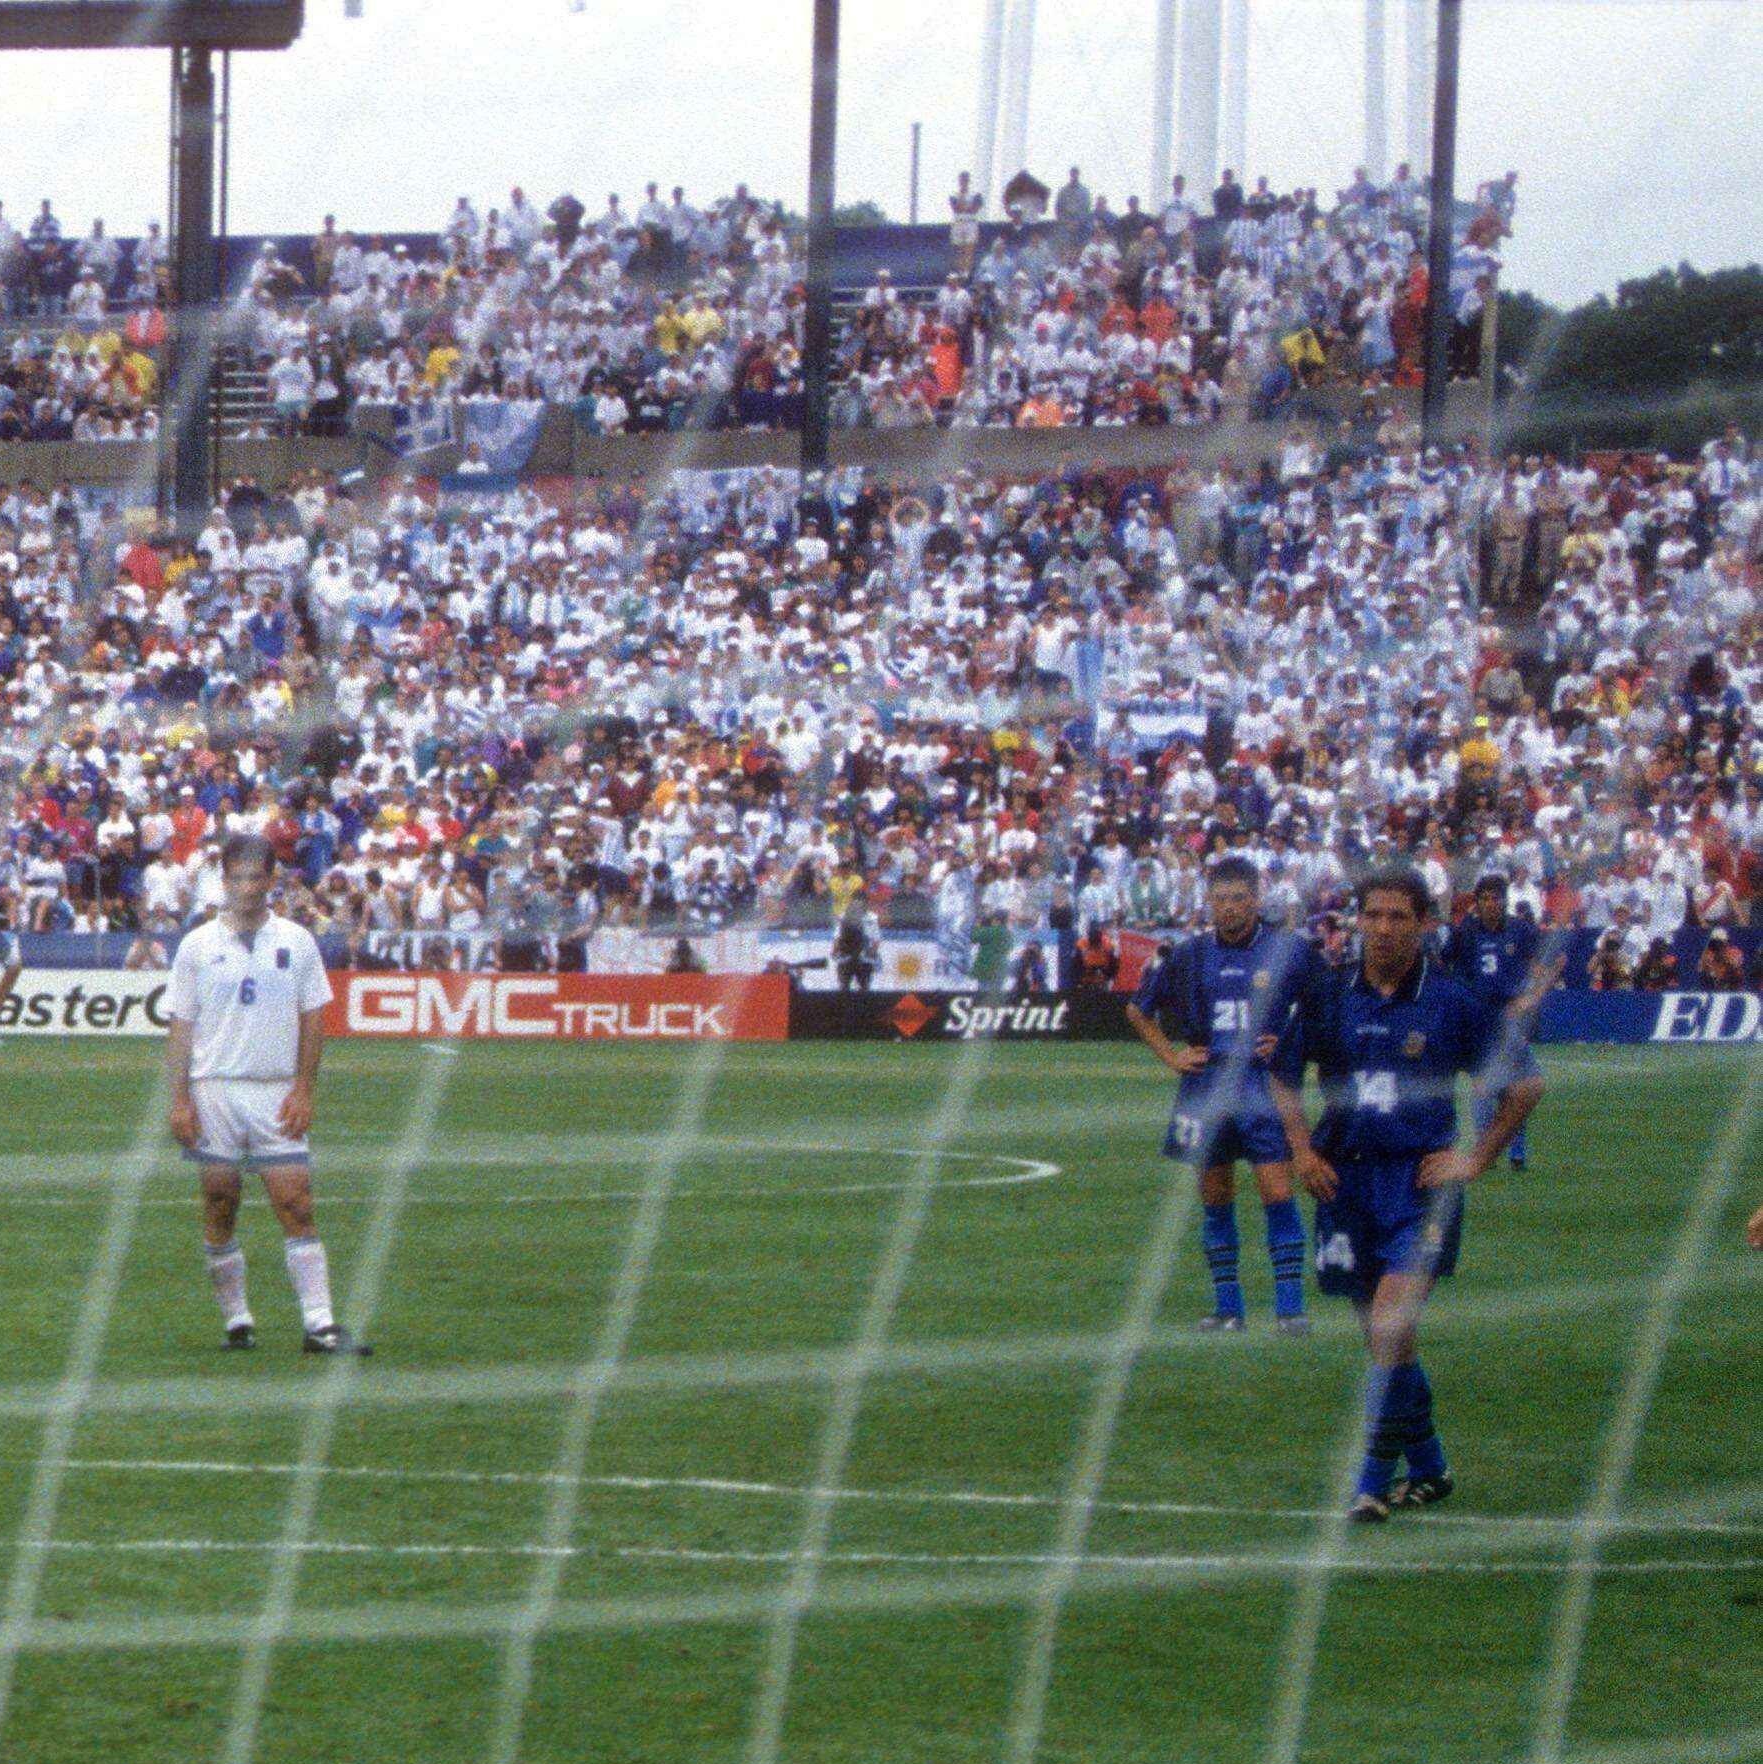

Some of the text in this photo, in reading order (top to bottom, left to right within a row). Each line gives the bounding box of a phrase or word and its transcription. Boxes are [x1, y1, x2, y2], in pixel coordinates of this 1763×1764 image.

[239, 976, 257, 1006] 6
[347, 978, 733, 1036] GMC TRUCK
[945, 997, 1070, 1040] Sprint
[1212, 1000, 1250, 1031] 21
[1649, 992, 1763, 1041] ED
